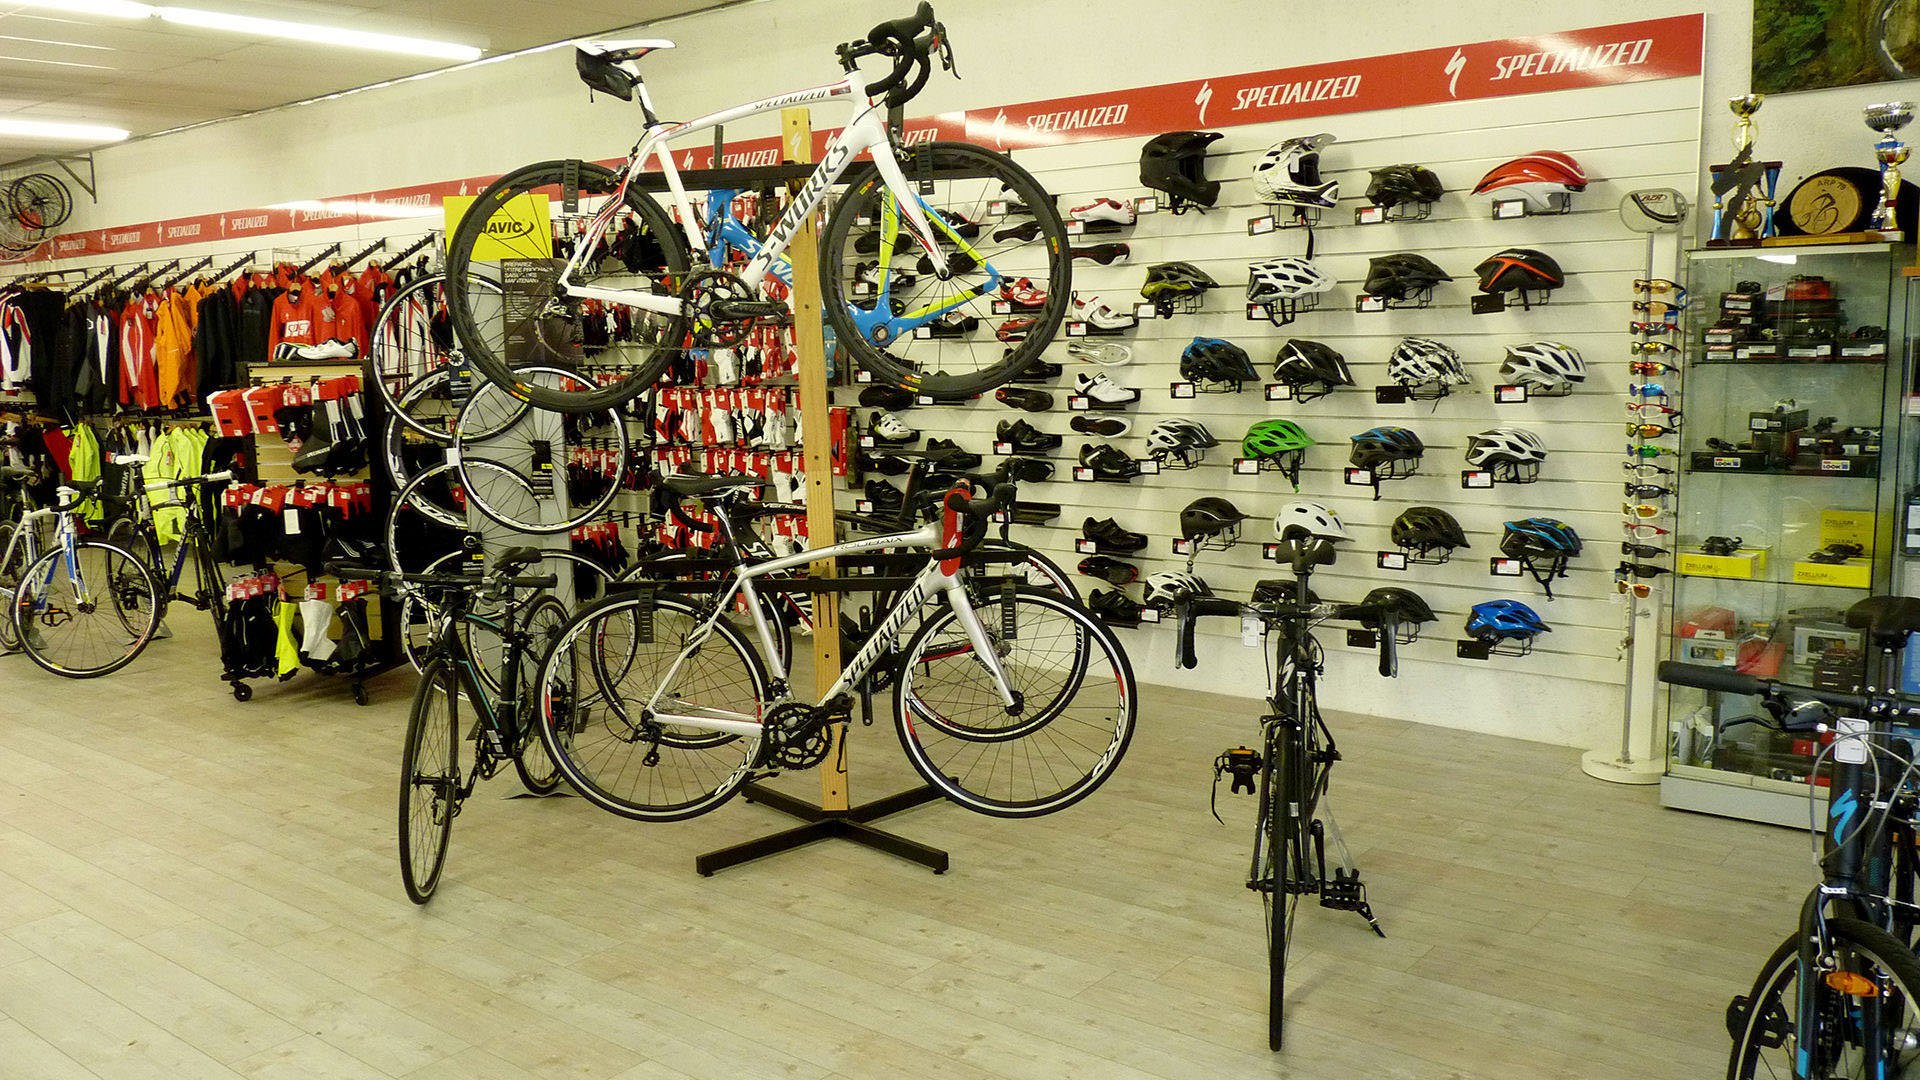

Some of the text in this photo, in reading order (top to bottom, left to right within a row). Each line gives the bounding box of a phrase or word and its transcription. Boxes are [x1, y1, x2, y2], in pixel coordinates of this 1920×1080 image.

[1490, 38, 1653, 81] SPECIALIZED
[752, 89, 827, 112] SPECIALIZED
[1232, 75, 1359, 111] SPECIALIZED
[1025, 103, 1129, 134] SPECIALIZED
[707, 148, 779, 169] SECIALIZED
[756, 144, 849, 270] S-WORKS
[168, 223, 201, 239] SPECIALIZED
[232, 215, 268, 231] SPECIALIZED
[111, 231, 141, 246] SPECIALIZED
[843, 583, 925, 692] SPECIALIZED
